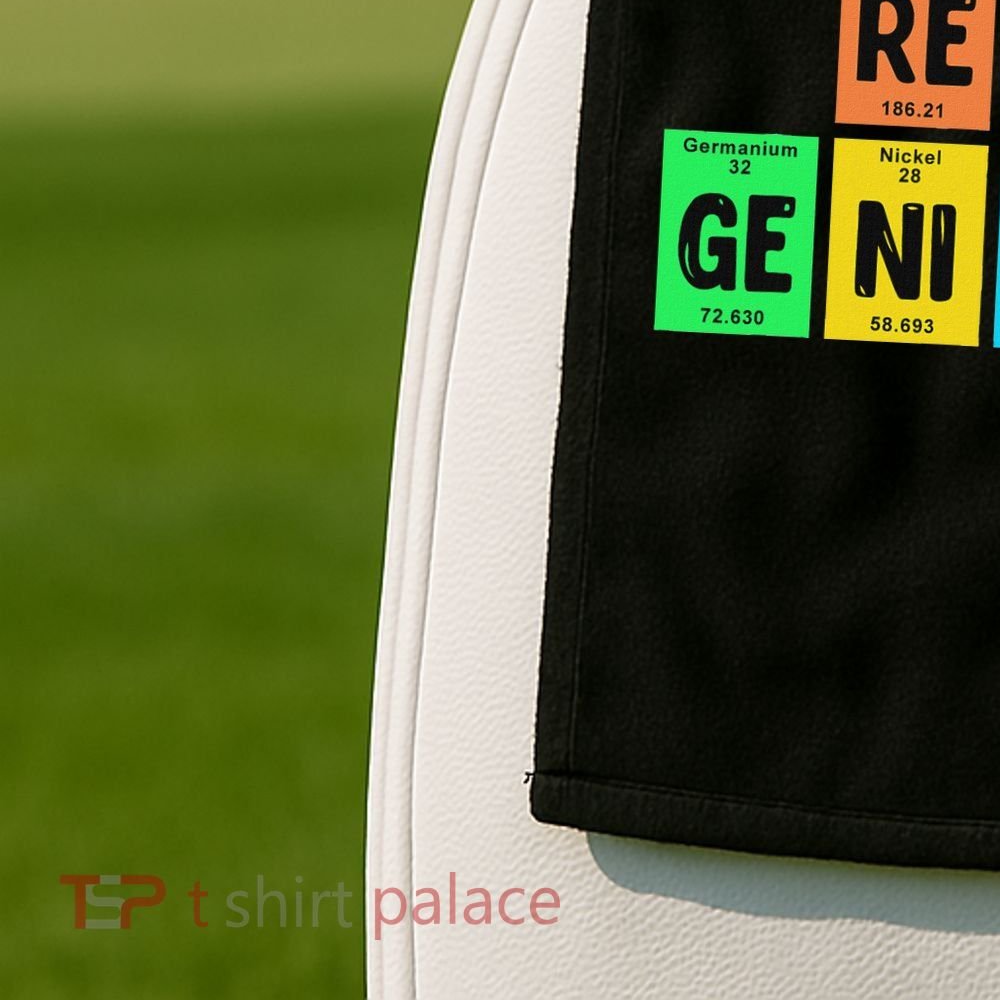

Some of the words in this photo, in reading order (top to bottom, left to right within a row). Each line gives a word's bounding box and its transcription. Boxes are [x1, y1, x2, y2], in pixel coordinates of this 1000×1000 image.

[883, 101, 942, 118] 186.21
[684, 138, 797, 157] Germanium
[880, 147, 941, 164] Nickel
[730, 159, 750, 174] 32
[899, 168, 920, 183] 28
[678, 193, 796, 293] GE
[855, 200, 956, 302] NI
[701, 308, 764, 325] 72.630
[871, 316, 933, 333] 58.693
